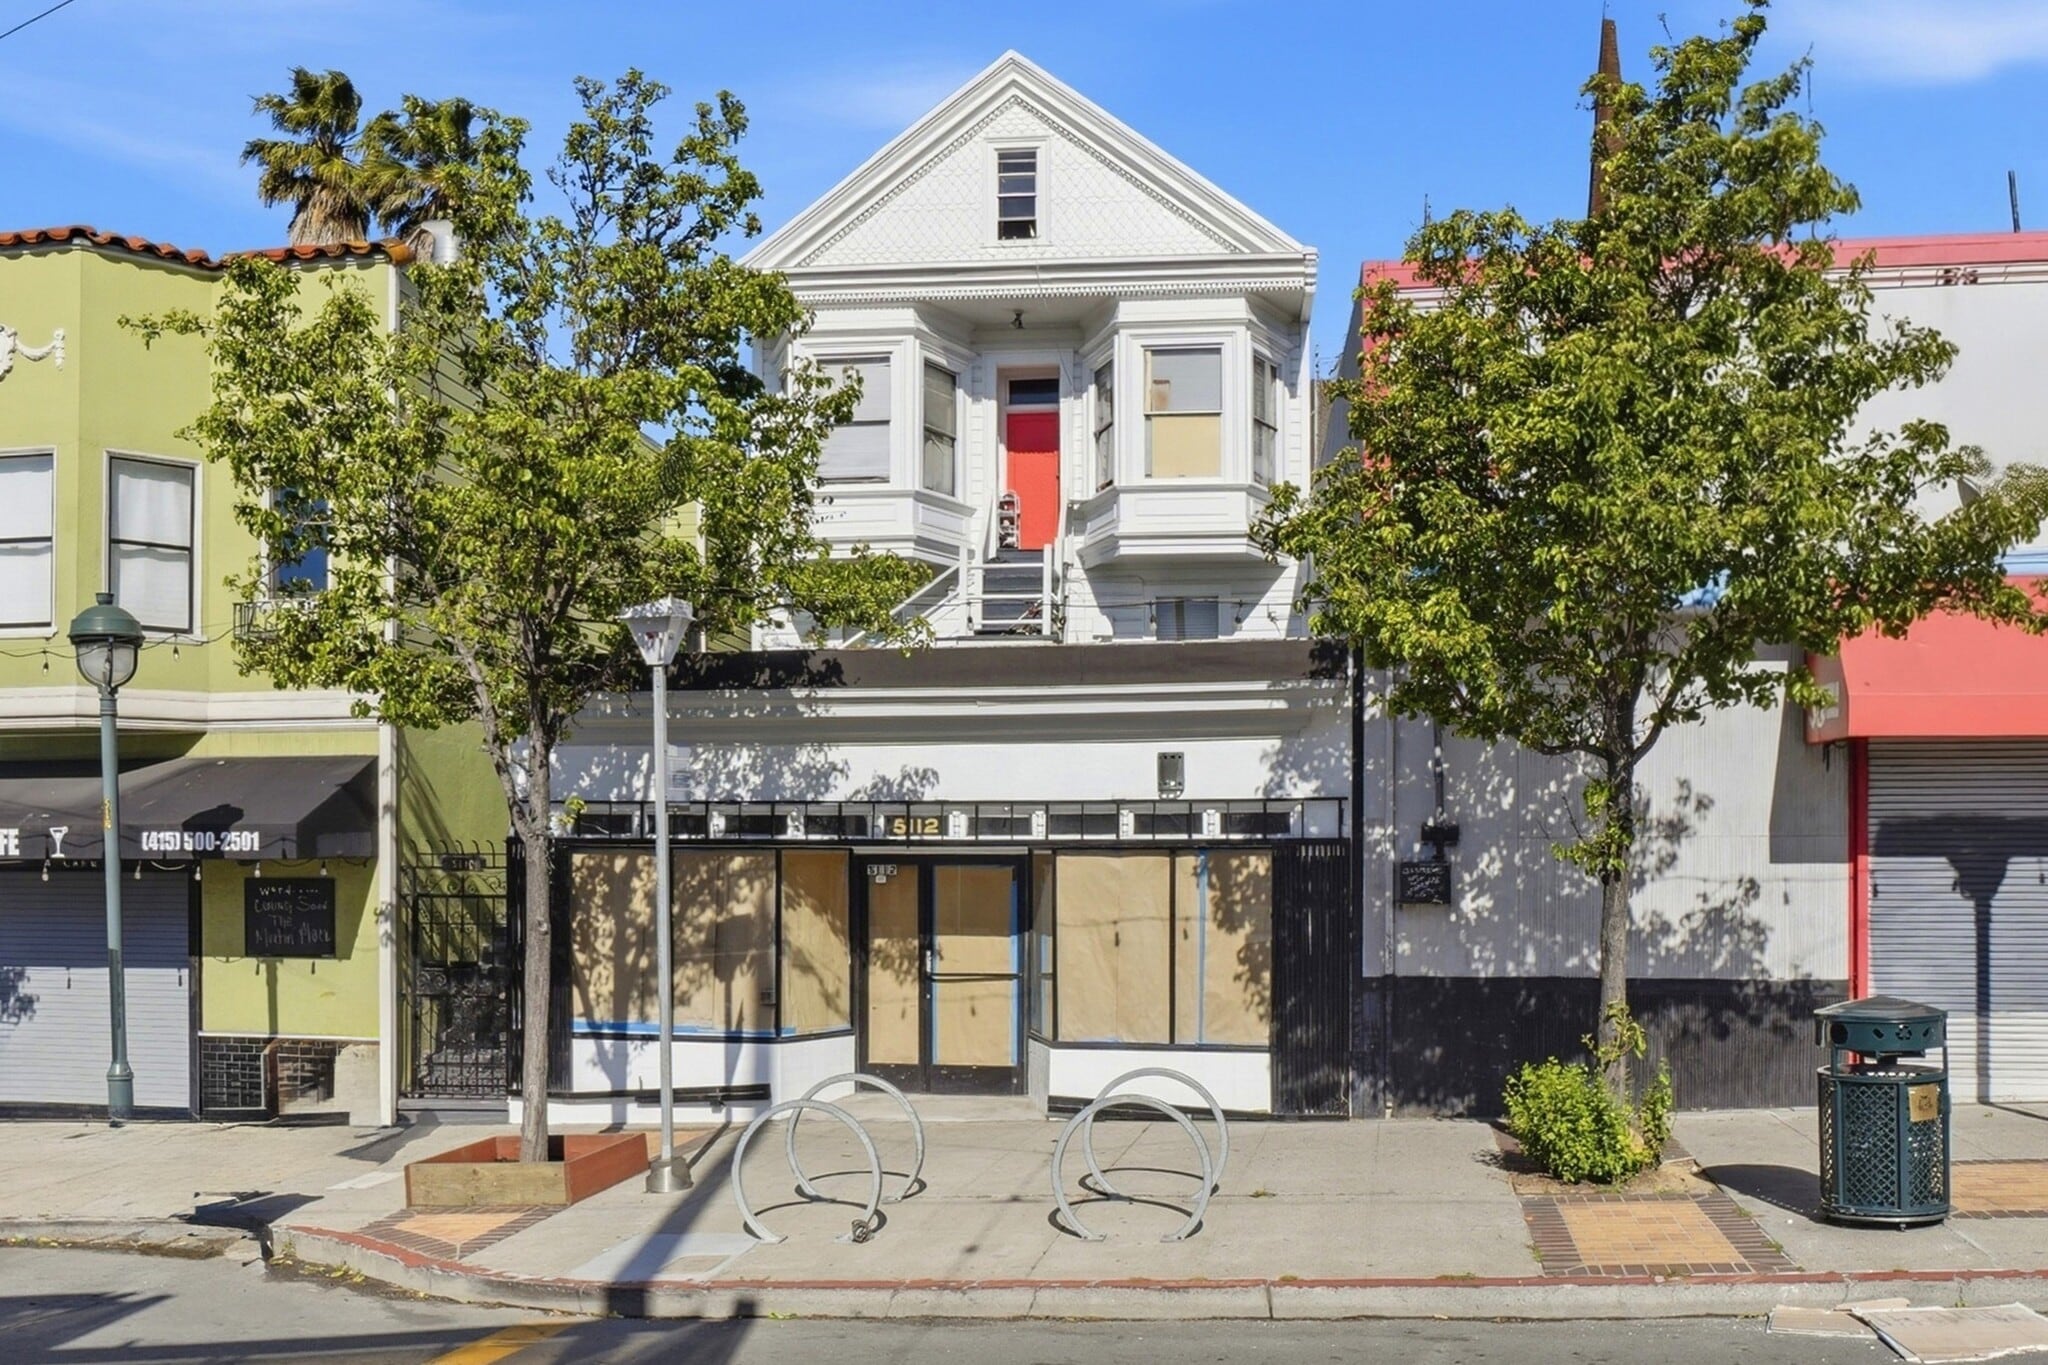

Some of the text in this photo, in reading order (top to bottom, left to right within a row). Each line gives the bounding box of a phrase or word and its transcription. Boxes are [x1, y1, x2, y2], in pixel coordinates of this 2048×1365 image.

[893, 818, 939, 834] 5112
[142, 831, 260, 851] (415) 500-2501
